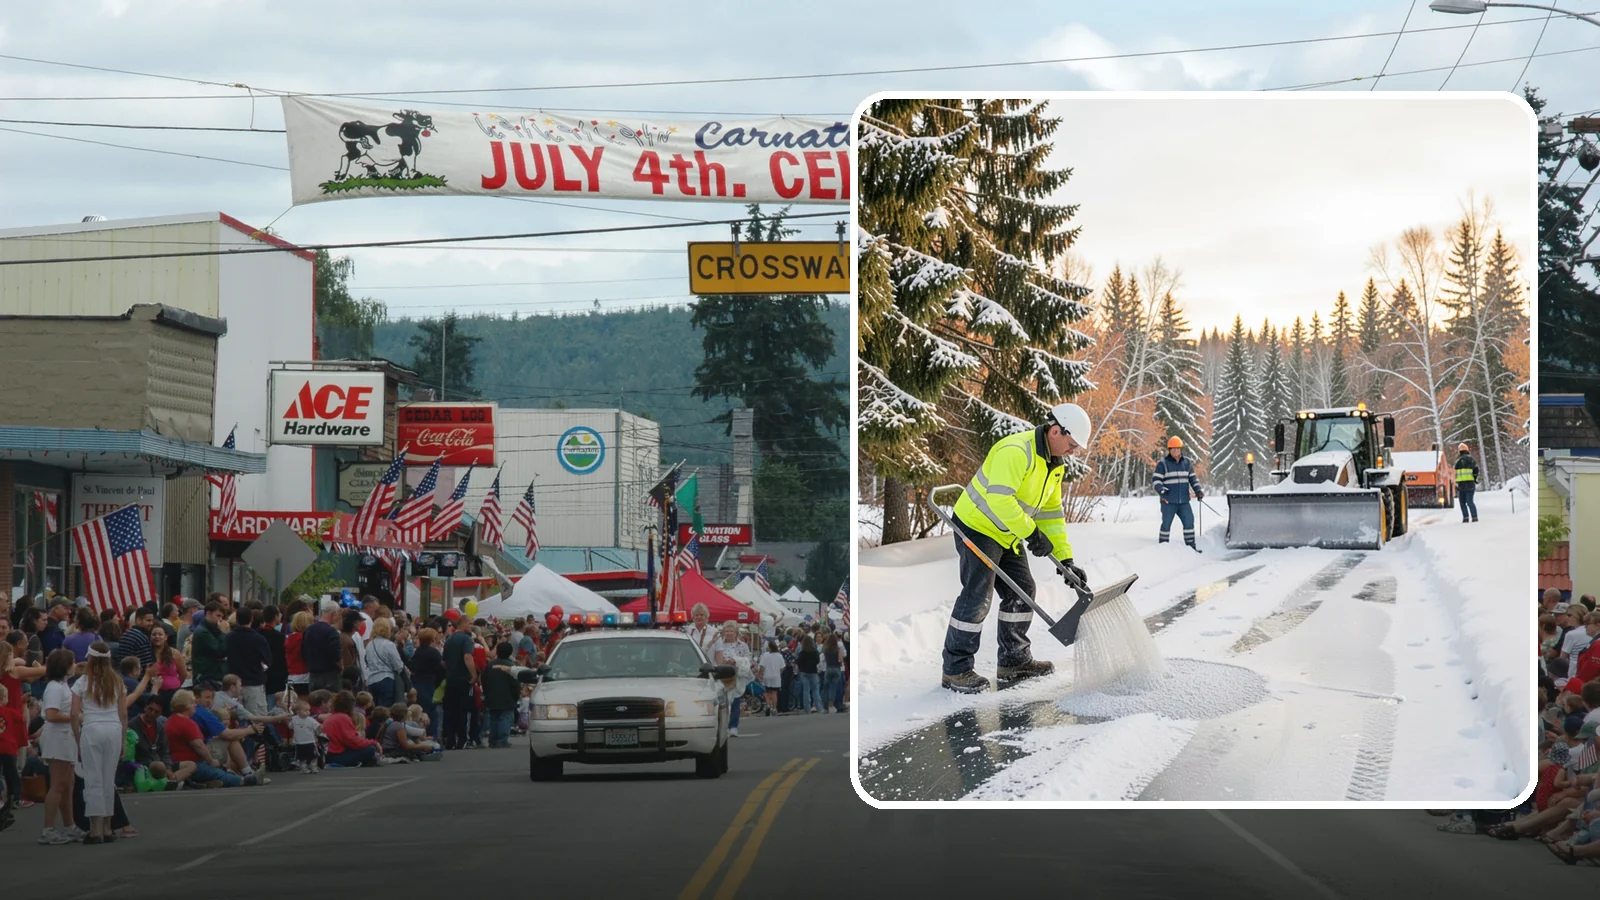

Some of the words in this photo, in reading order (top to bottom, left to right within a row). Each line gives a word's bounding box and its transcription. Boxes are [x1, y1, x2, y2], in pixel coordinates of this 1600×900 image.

[481, 141, 605, 193] JULY
[632, 150, 746, 198] 4th.
[697, 254, 850, 280] CROSSWA
[283, 380, 373, 420] ACE
[405, 409, 452, 422] CEDAR
[461, 409, 485, 422] LOG
[283, 421, 371, 437] Hardware
[416, 428, 477, 448] Coca-Cola
[353, 467, 386, 480] Simpl
[95, 485, 124, 494] Vincent
[126, 486, 136, 494] de
[137, 486, 155, 495] Paul
[212, 516, 331, 535] HARDARE
[688, 526, 741, 535] CRNATION
[699, 535, 730, 543] GLASS
